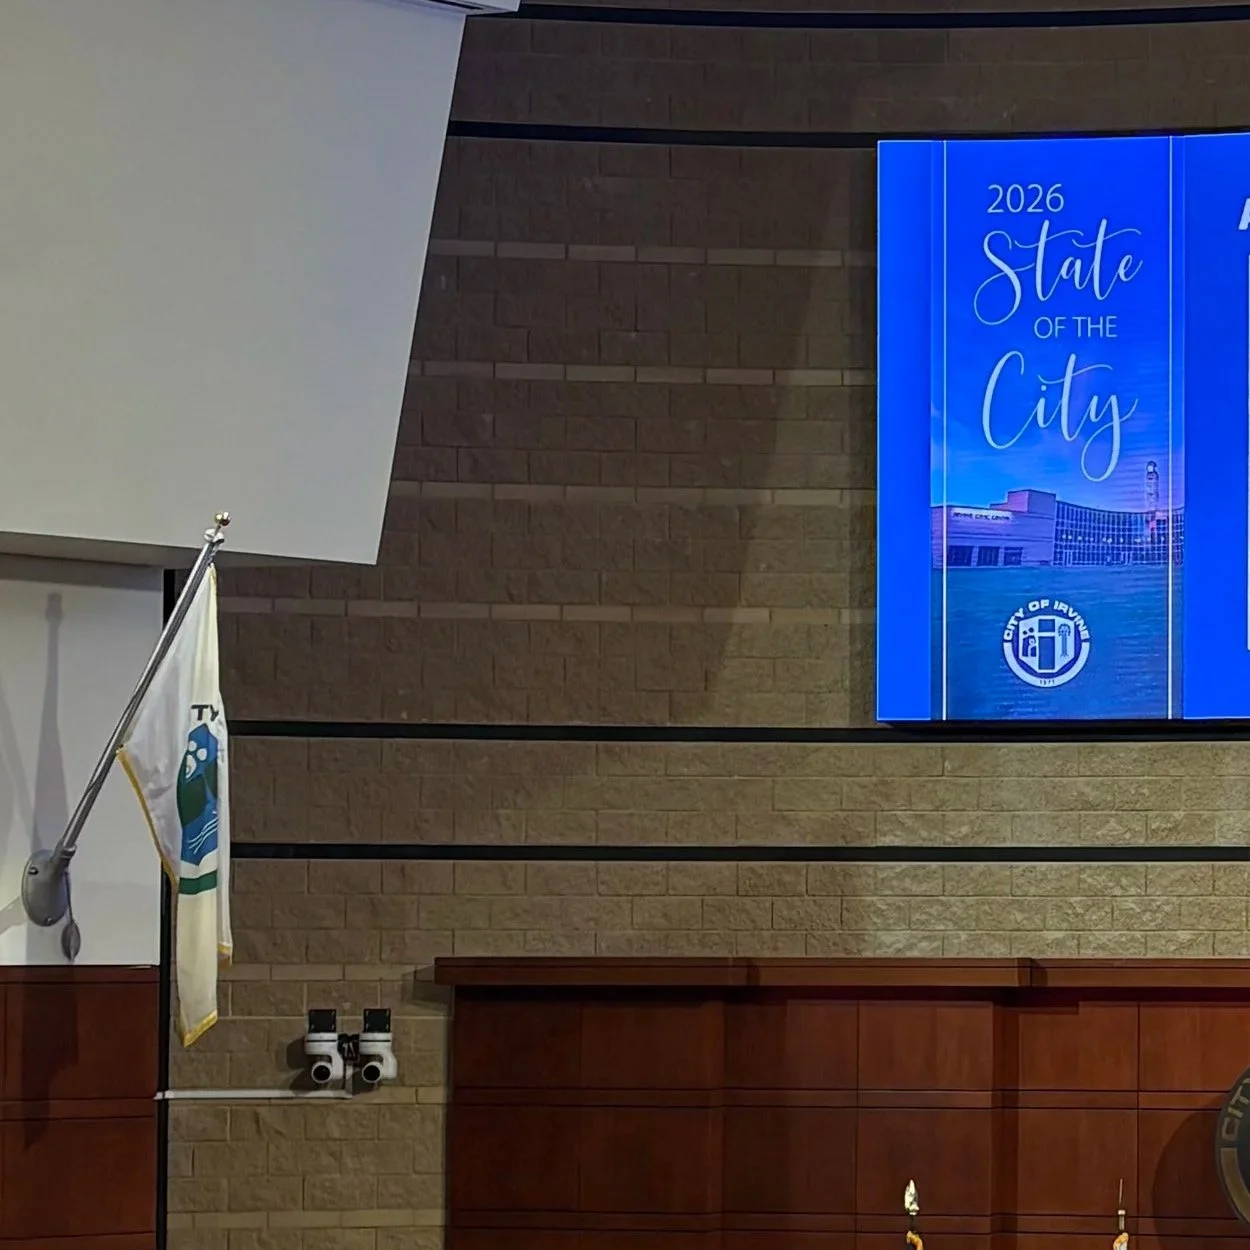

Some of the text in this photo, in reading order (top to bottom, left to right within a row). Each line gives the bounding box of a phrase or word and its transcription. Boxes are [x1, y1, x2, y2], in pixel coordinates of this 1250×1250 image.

[986, 183, 1065, 214] 2026
[973, 218, 1143, 325] State
[1033, 316, 1118, 339] OF THE
[982, 350, 1138, 482] City
[1003, 599, 1090, 641] CITY OF IRVINE
